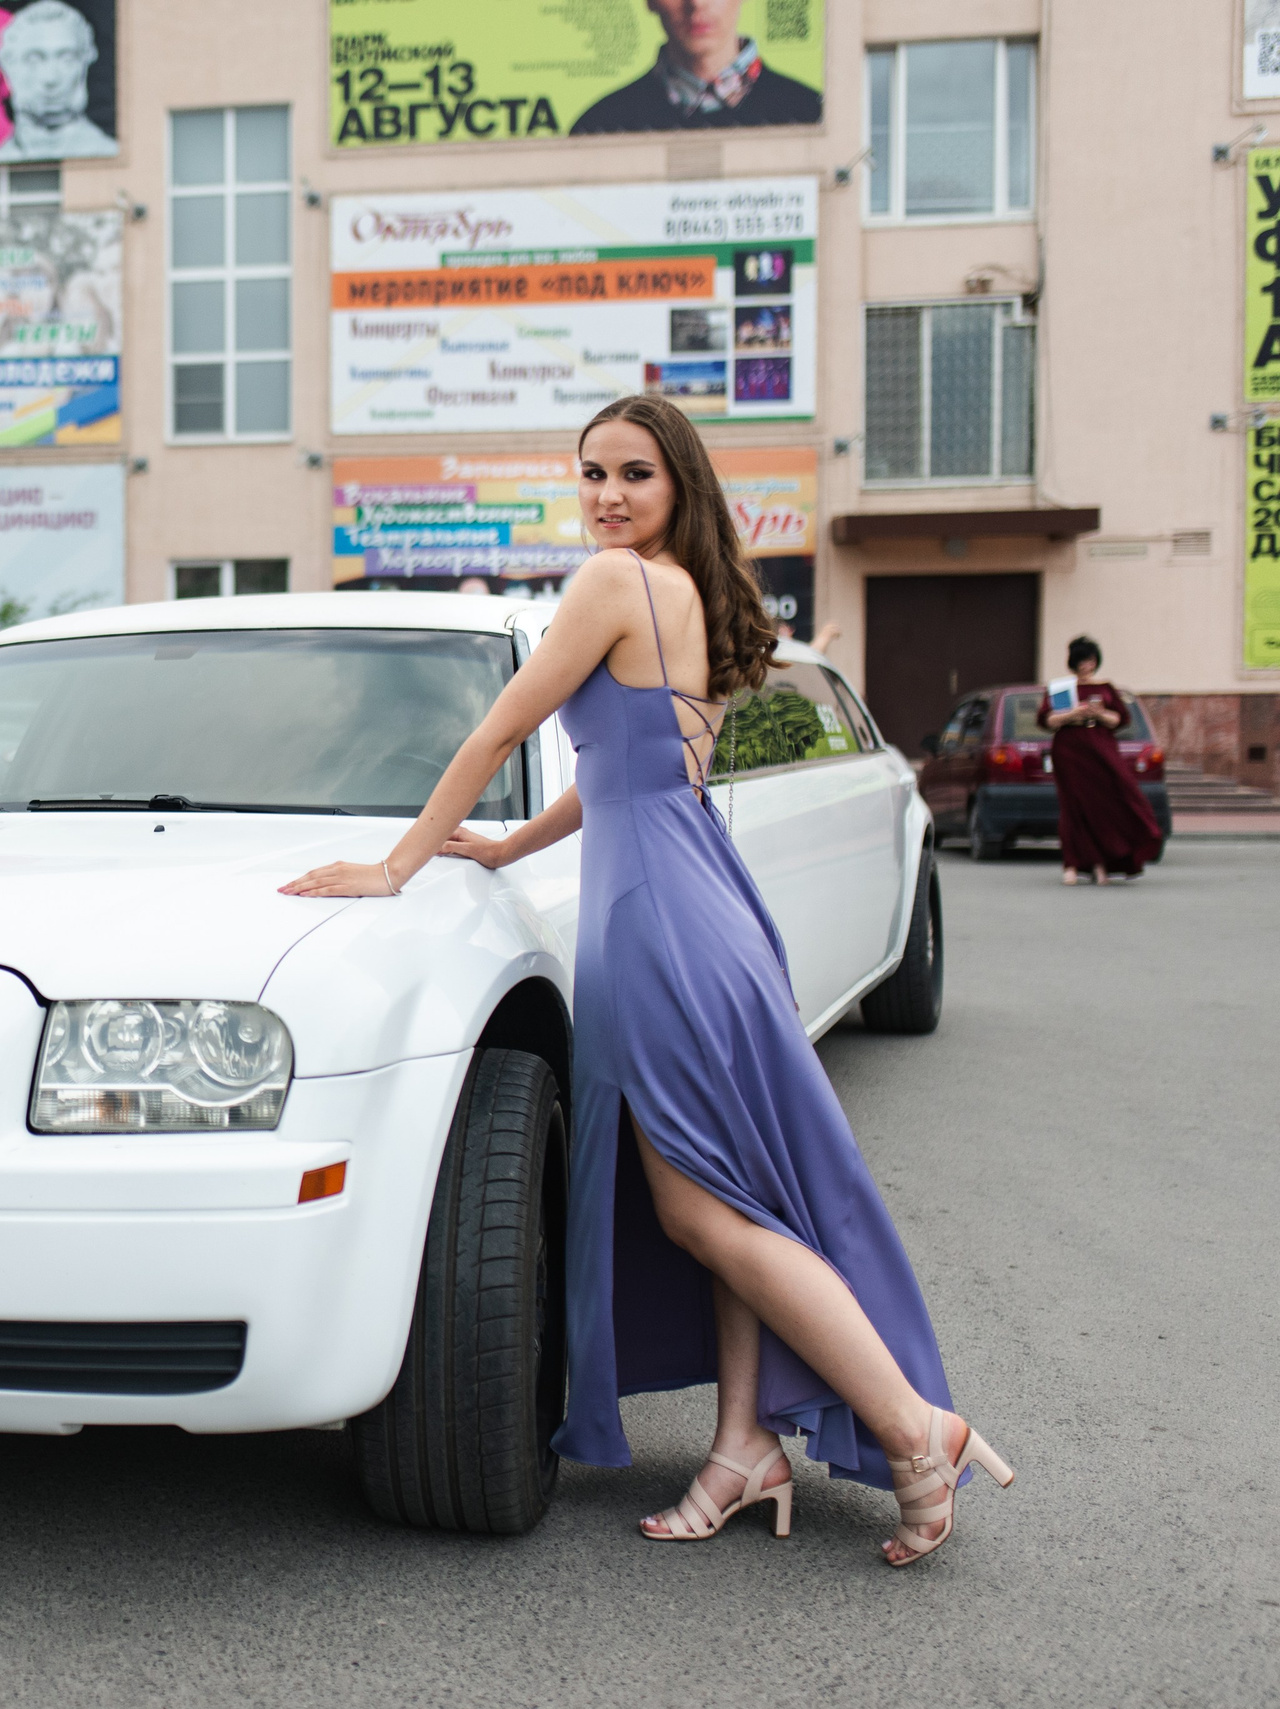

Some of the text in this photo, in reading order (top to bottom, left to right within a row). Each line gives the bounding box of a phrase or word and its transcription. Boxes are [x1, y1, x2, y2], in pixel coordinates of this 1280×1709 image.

[337, 97, 560, 143] АВГУСТА
[350, 205, 514, 249] Октябрь
[348, 268, 709, 307] мероприятие «под ключ»
[350, 317, 440, 340] Концерты
[488, 358, 574, 384] Конкурсы
[426, 385, 517, 407] Фестивали
[441, 456, 568, 481] Запишись
[343, 482, 470, 505] Вокальные
[362, 503, 540, 531] Художественные
[345, 525, 501, 552] Театральные
